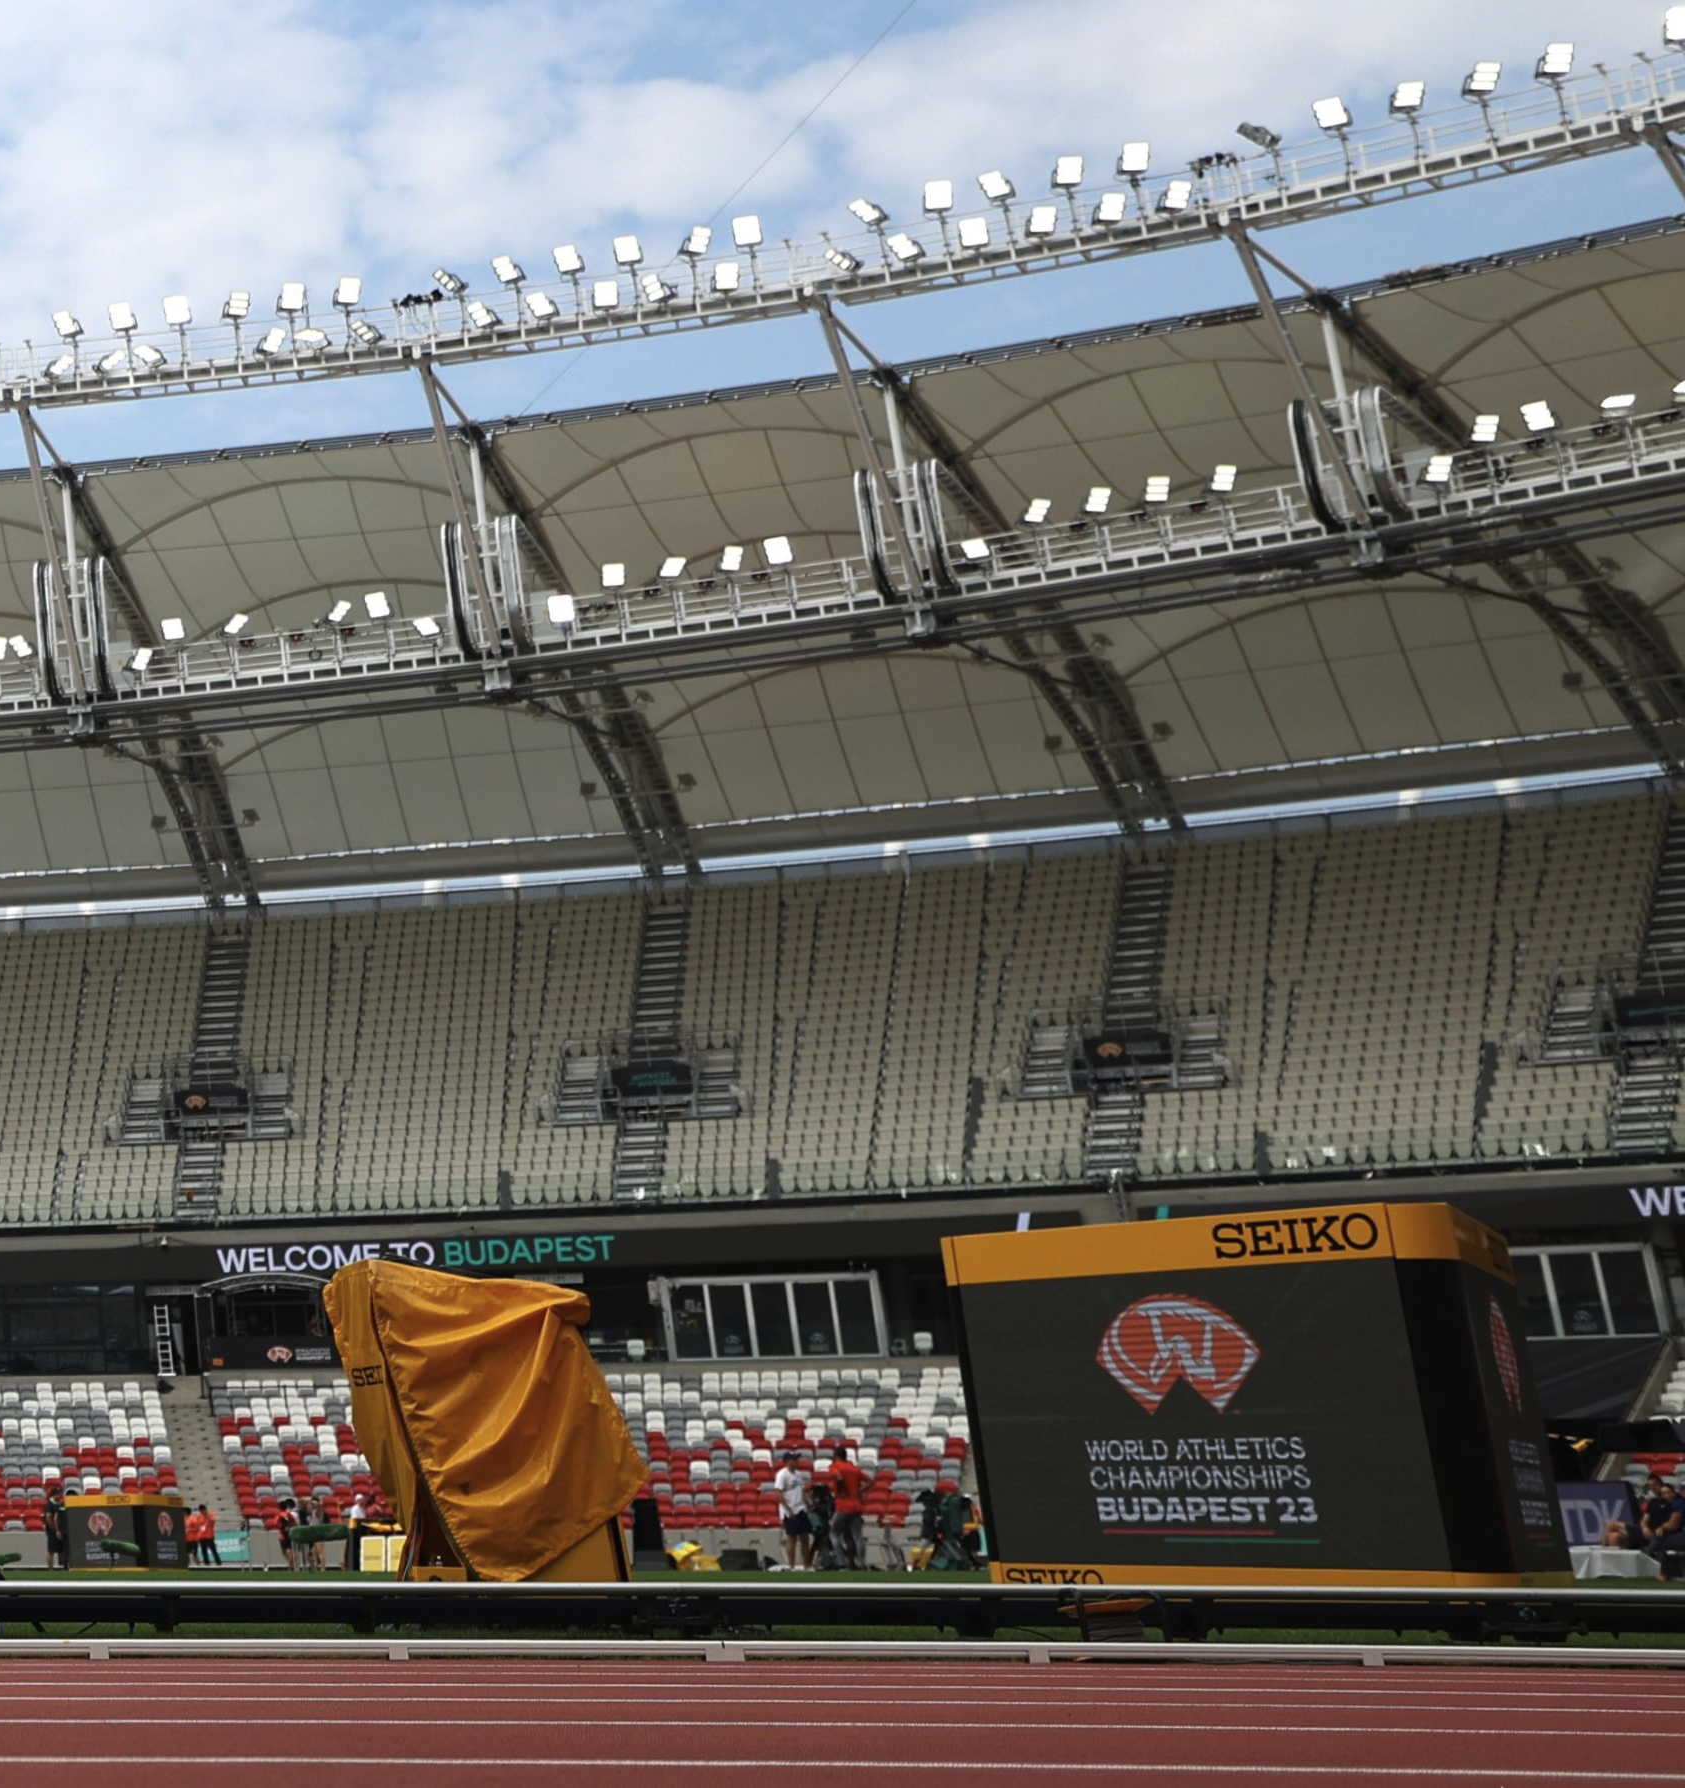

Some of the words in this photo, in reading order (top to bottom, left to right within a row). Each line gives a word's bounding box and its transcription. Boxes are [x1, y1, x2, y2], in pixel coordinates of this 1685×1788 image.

[1212, 1212, 1379, 1259] SEIKO
[388, 1241, 435, 1267] TO
[443, 1234, 615, 1267] BUDAPEST
[351, 1365, 383, 1387] SEI
[1085, 1439, 1168, 1462] WORLD
[1175, 1436, 1306, 1461] ATHLETICS
[1089, 1464, 1312, 1491] CHAMPIONSHIPS
[1096, 1497, 1270, 1523] BUDAPEST
[1276, 1496, 1319, 1523] 23
[1559, 1499, 1625, 1544] TDK
[1005, 1568, 1104, 1585] SEIKO
